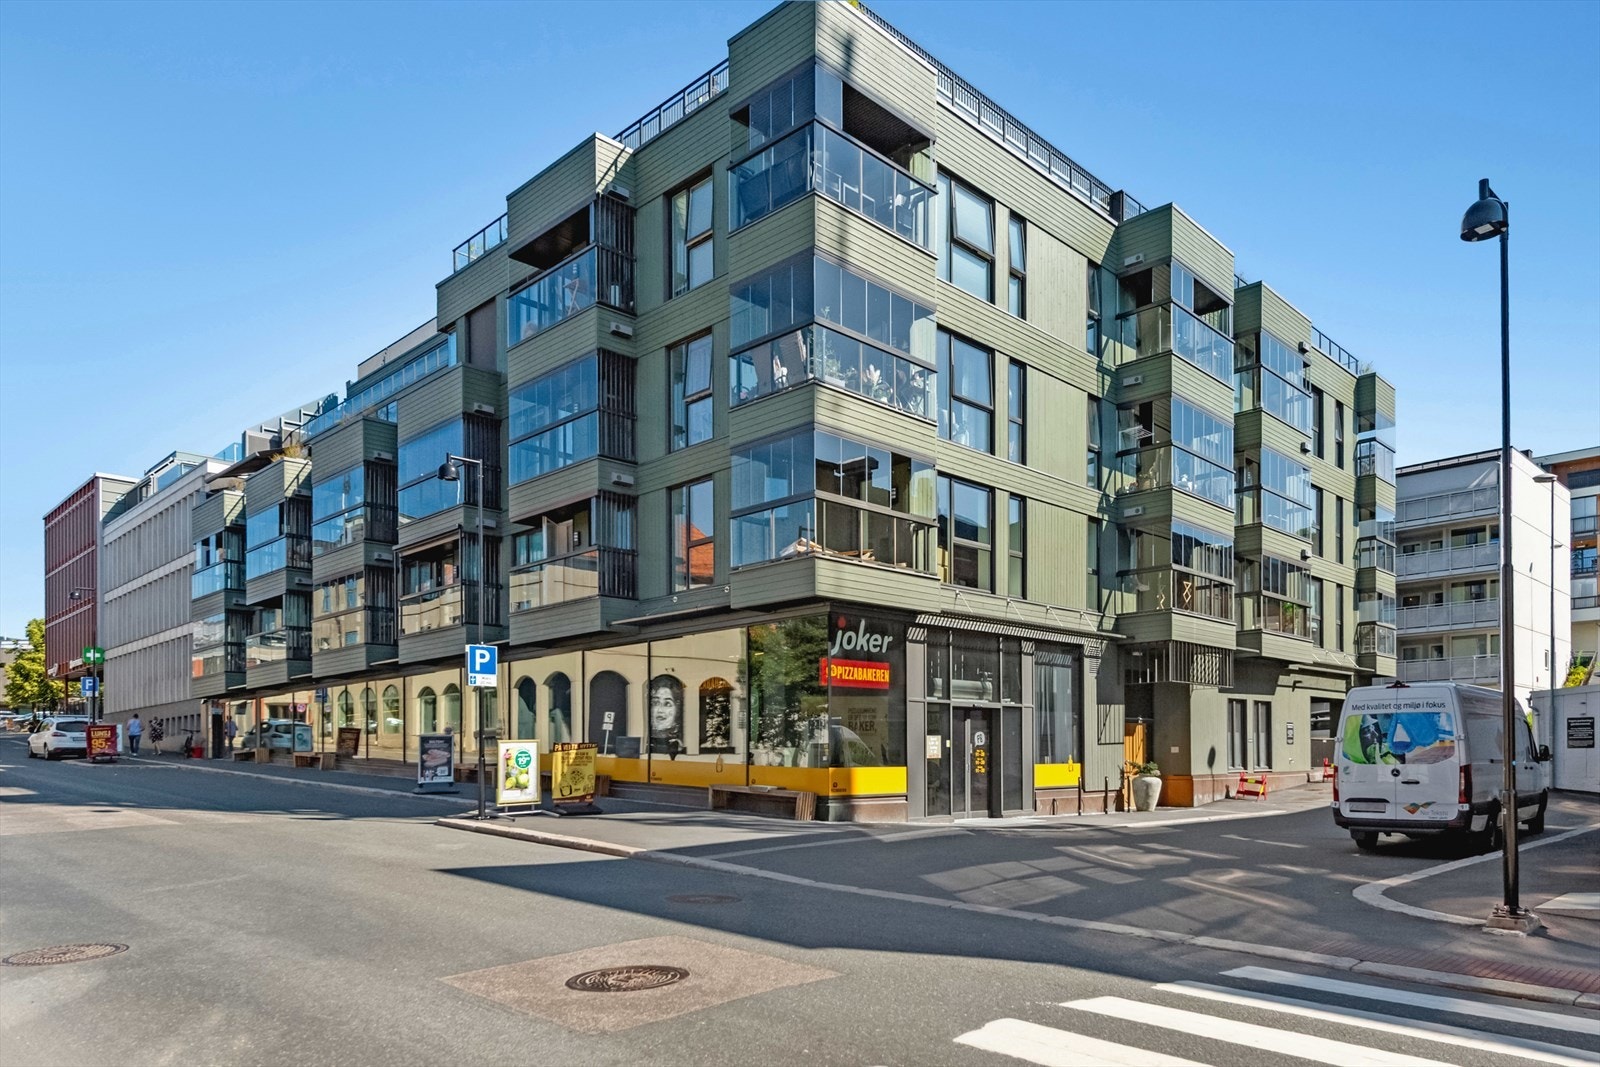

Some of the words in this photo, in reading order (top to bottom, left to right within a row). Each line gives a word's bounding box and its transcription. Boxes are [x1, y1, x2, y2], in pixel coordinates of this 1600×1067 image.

[831, 615, 893, 656] joker
[475, 649, 490, 671] P
[837, 666, 890, 682] PIZZABAKEREN
[1394, 703, 1402, 711] og
[1425, 701, 1446, 709] fokus
[91, 730, 111, 738] LUNSJ
